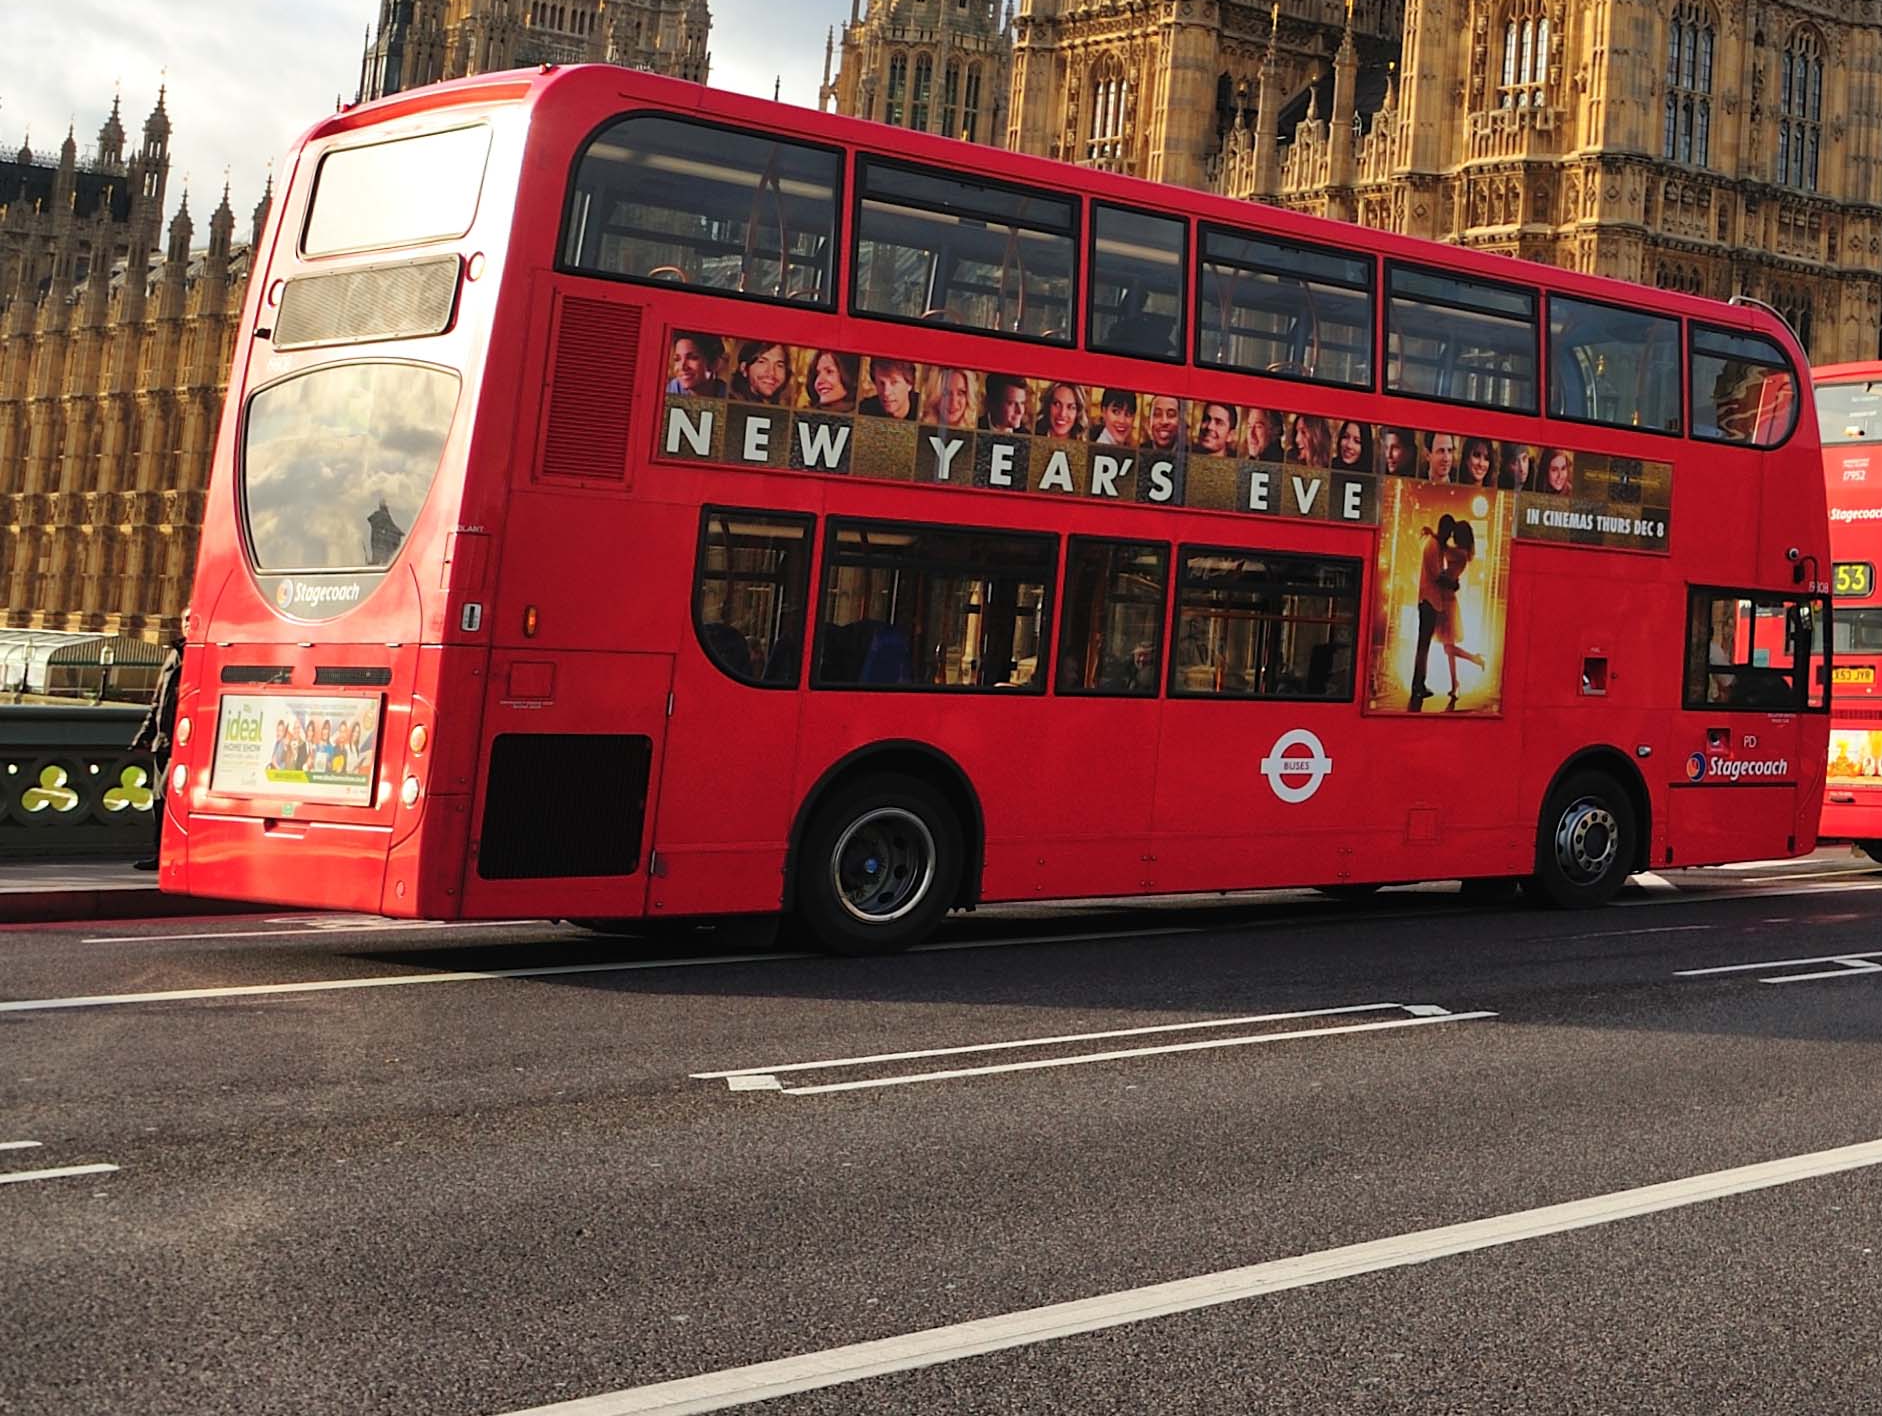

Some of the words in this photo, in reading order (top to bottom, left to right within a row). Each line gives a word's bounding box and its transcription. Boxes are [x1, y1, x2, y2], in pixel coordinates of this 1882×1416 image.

[665, 407, 850, 469] NEW
[929, 437, 1174, 502] YEAR'S
[1250, 472, 1362, 519] EVE
[1526, 508, 1540, 525] IN
[1543, 509, 1593, 530] CINEMAS
[1596, 515, 1631, 534] THURS
[1633, 521, 1654, 537] DEC
[1656, 522, 1665, 538] 8
[1836, 565, 1866, 591] 53
[294, 581, 360, 607] Stagecoach
[224, 709, 264, 742] ideal
[1743, 735, 1757, 748] PD
[1283, 761, 1310, 770] BUSES
[1708, 756, 1788, 781] Stagecoach
